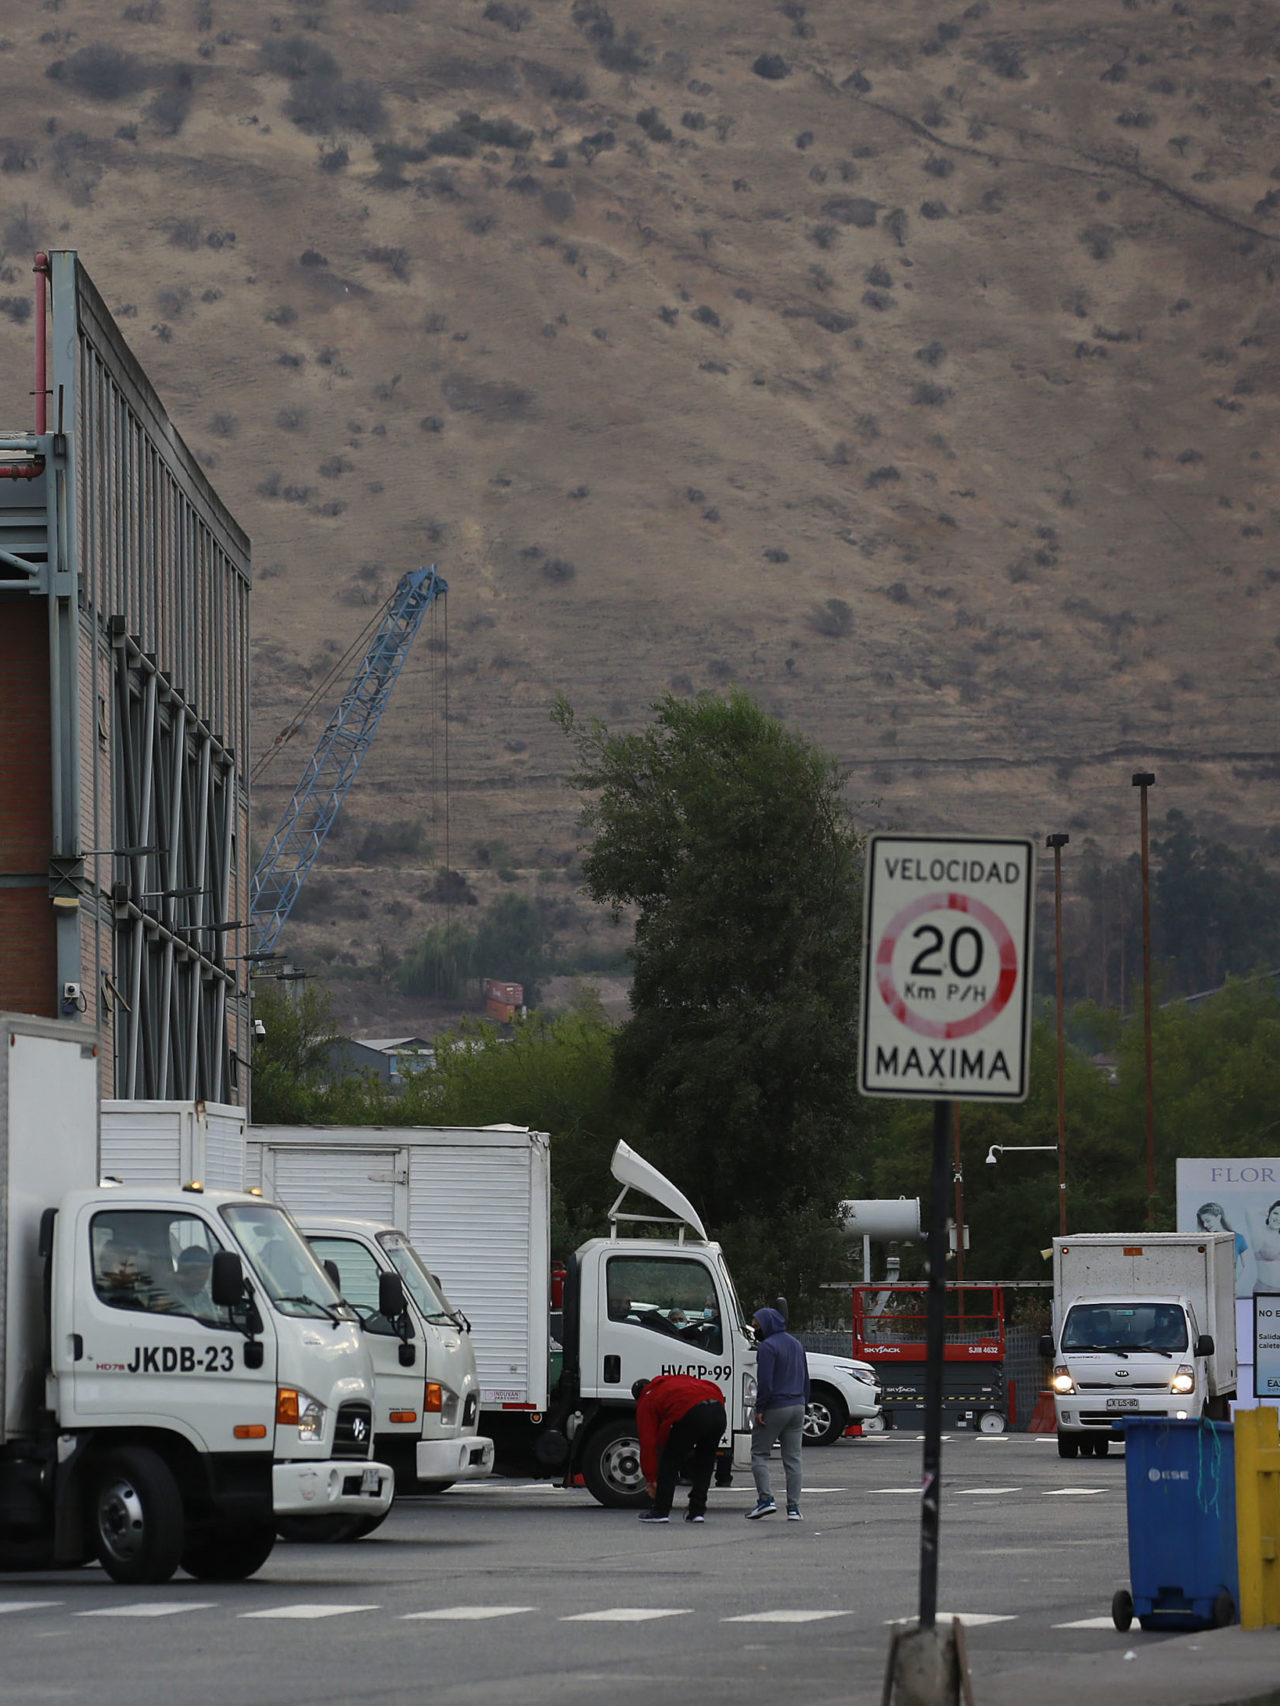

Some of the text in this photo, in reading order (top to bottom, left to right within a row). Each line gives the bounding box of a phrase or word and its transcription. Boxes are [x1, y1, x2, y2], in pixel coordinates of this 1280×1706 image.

[884, 858, 1020, 884] VELOCIDAD
[910, 925, 984, 978] 20
[904, 982, 986, 1001] Km P/H
[875, 1046, 1011, 1080] MAXIMA
[1211, 1167, 1276, 1182] FLOR
[127, 1345, 235, 1373] JKDB-23
[864, 1345, 901, 1353] SKYJACK
